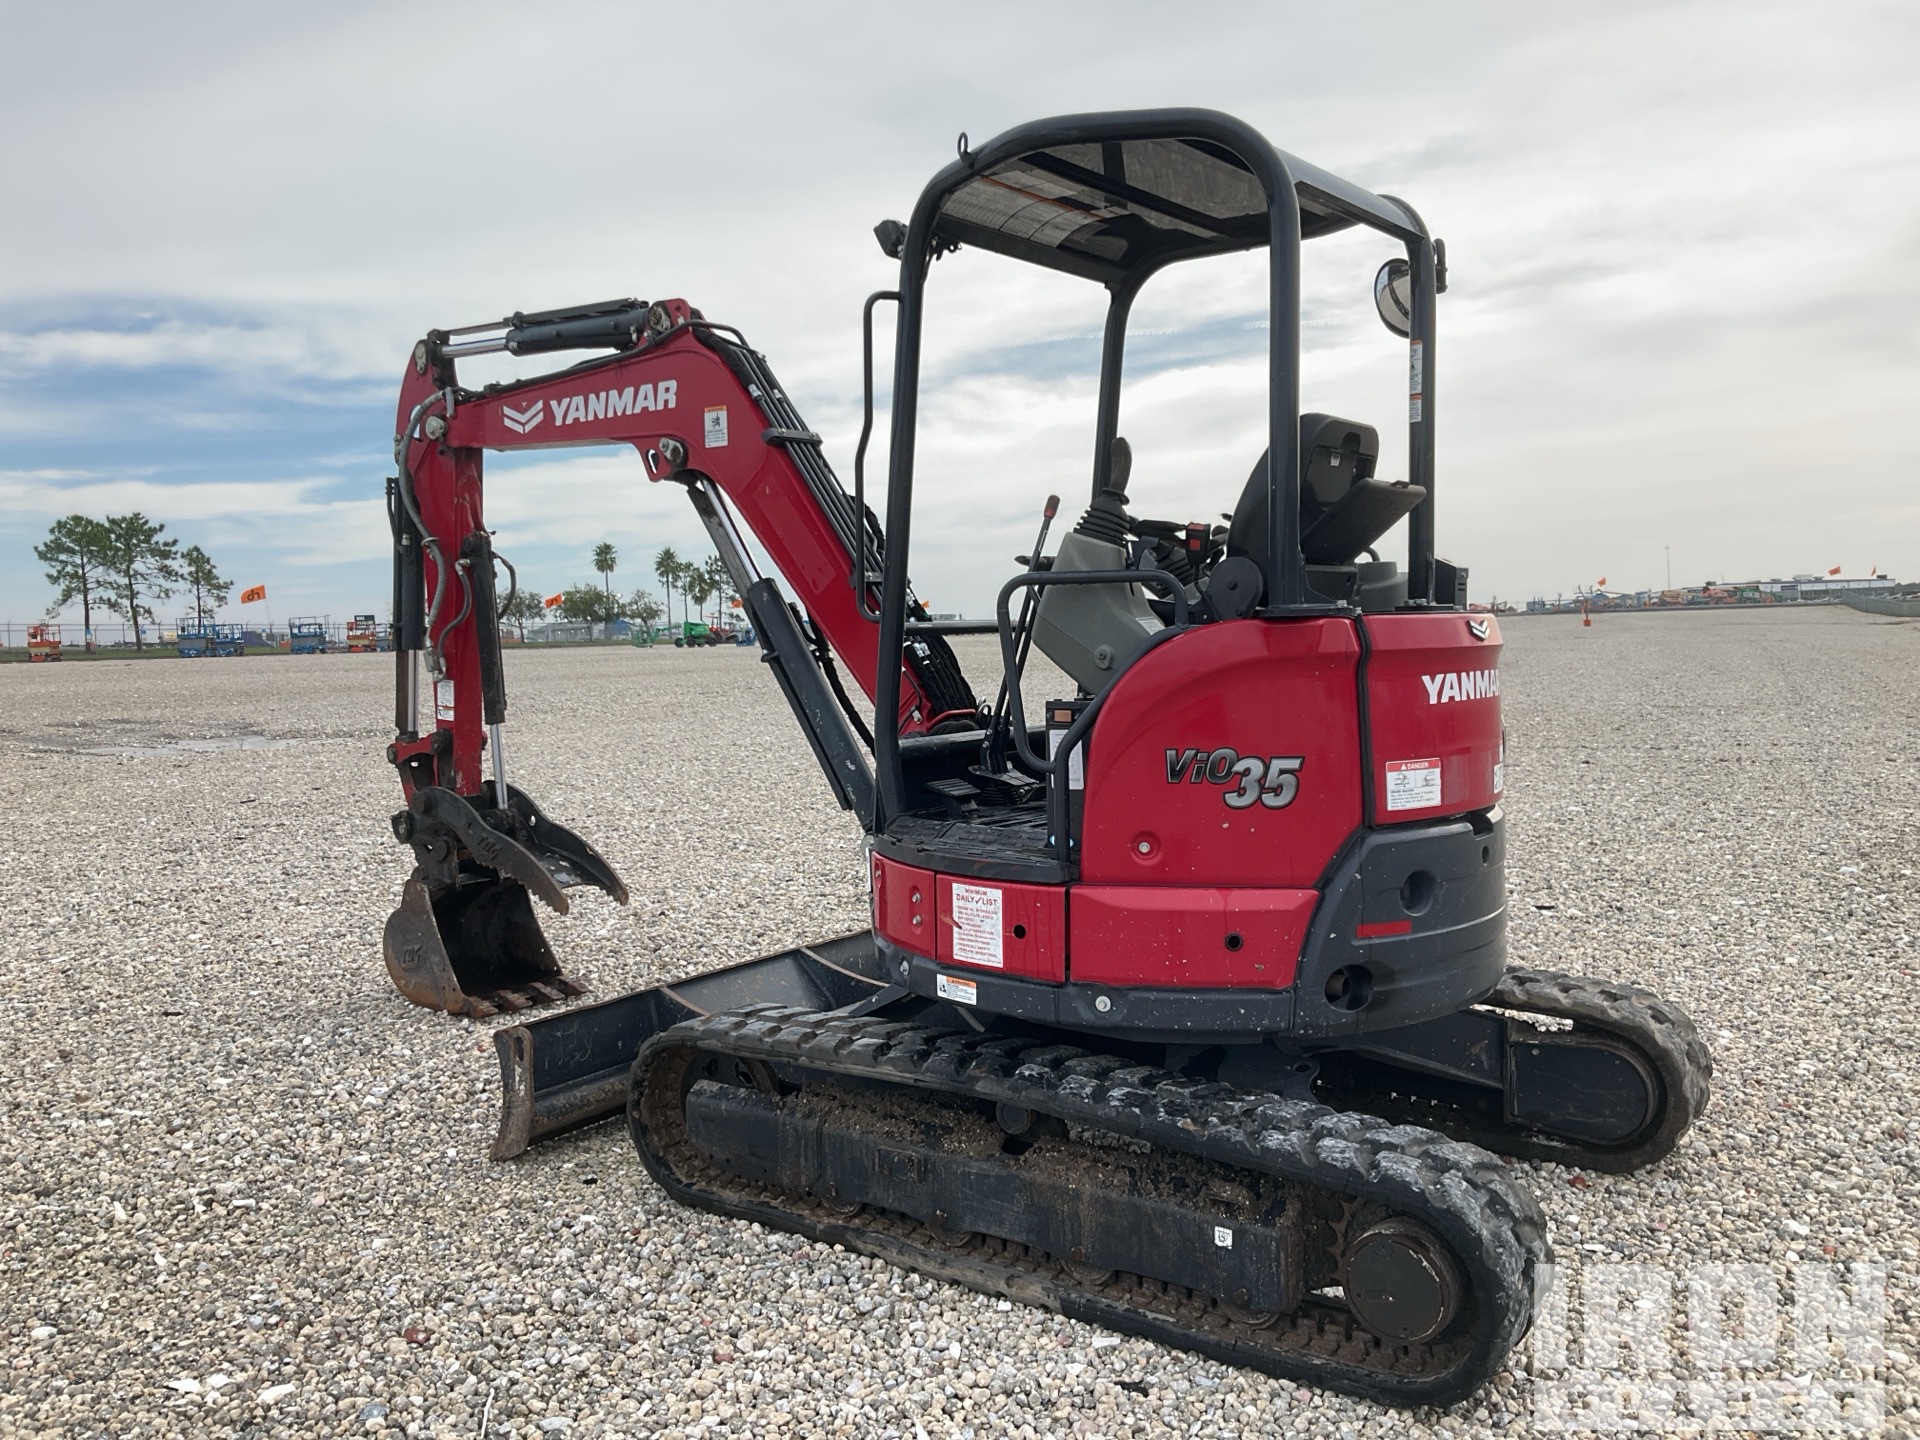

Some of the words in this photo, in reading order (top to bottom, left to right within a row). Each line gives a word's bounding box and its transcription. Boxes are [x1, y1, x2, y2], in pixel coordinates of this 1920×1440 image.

[551, 380, 677, 426] YANMAR
[1422, 670, 1499, 704] YANMA
[1407, 762, 1429, 770] DANGER
[956, 893, 974, 903] DAILY
[982, 898, 997, 906] LIST
